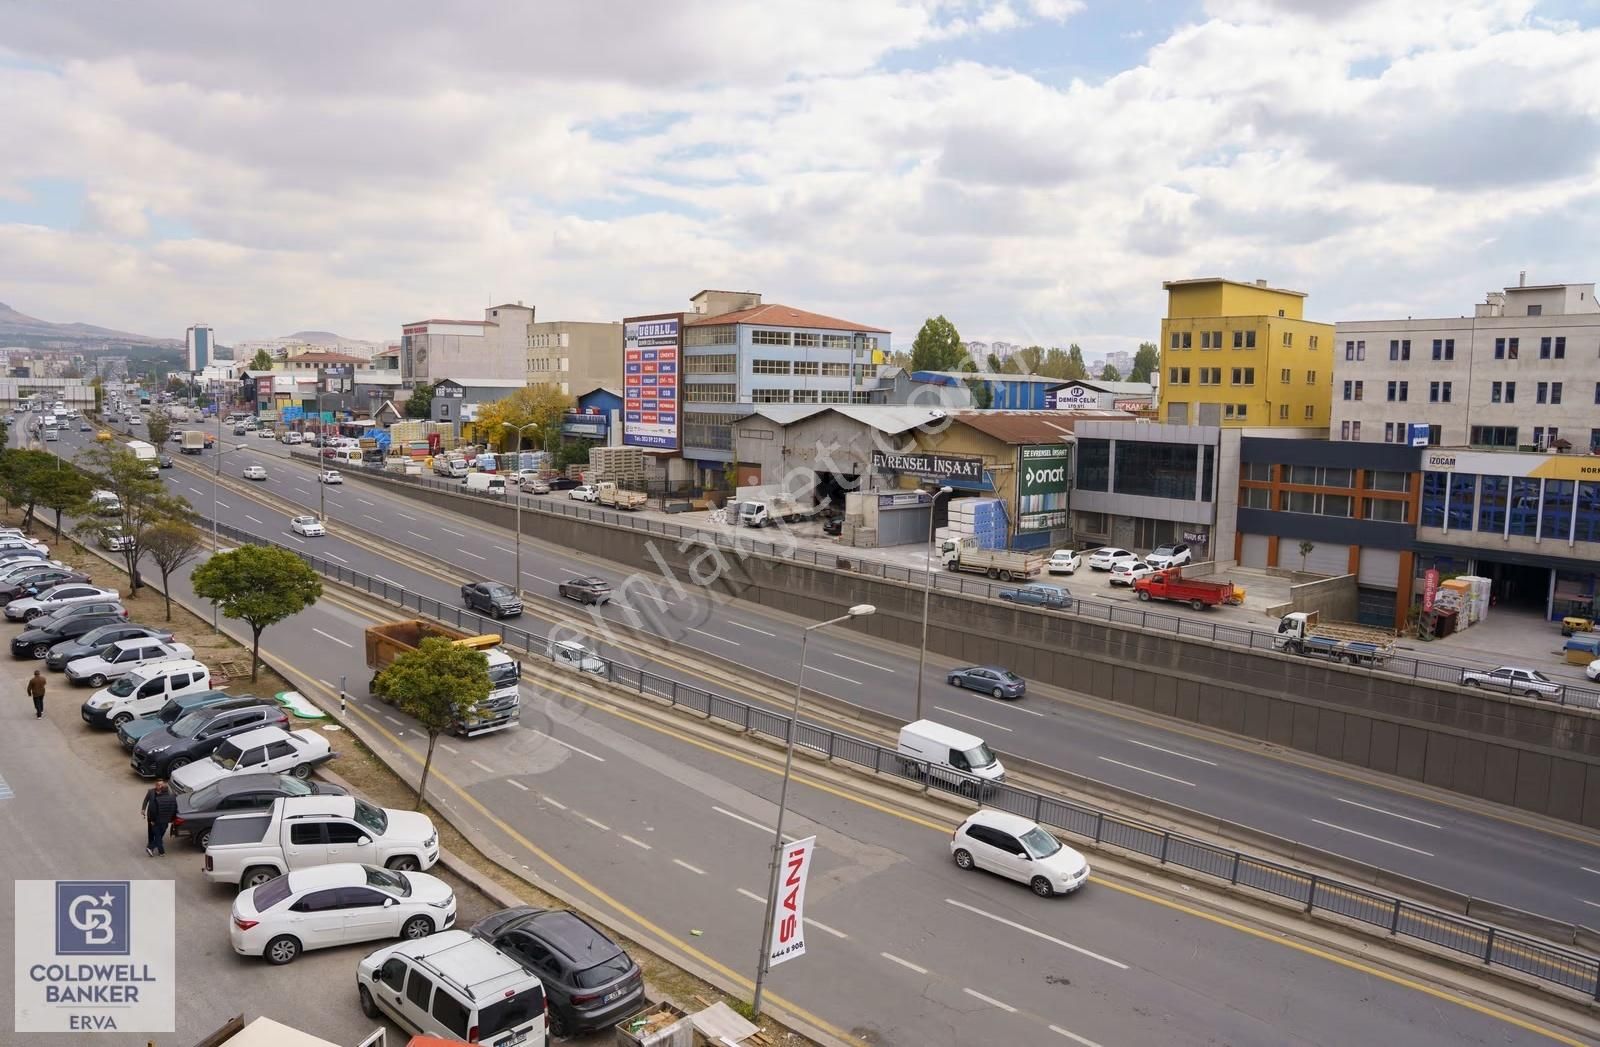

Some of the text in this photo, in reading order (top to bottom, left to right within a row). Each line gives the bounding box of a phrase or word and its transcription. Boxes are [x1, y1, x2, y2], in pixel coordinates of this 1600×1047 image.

[1030, 449, 1052, 457] EVRENSEL
[1052, 447, 1067, 457] İNŞAAT
[873, 454, 931, 471] EVRENSEL
[933, 456, 980, 477] İNŞAAT
[1035, 465, 1065, 483] onat
[771, 949, 785, 959] 444
